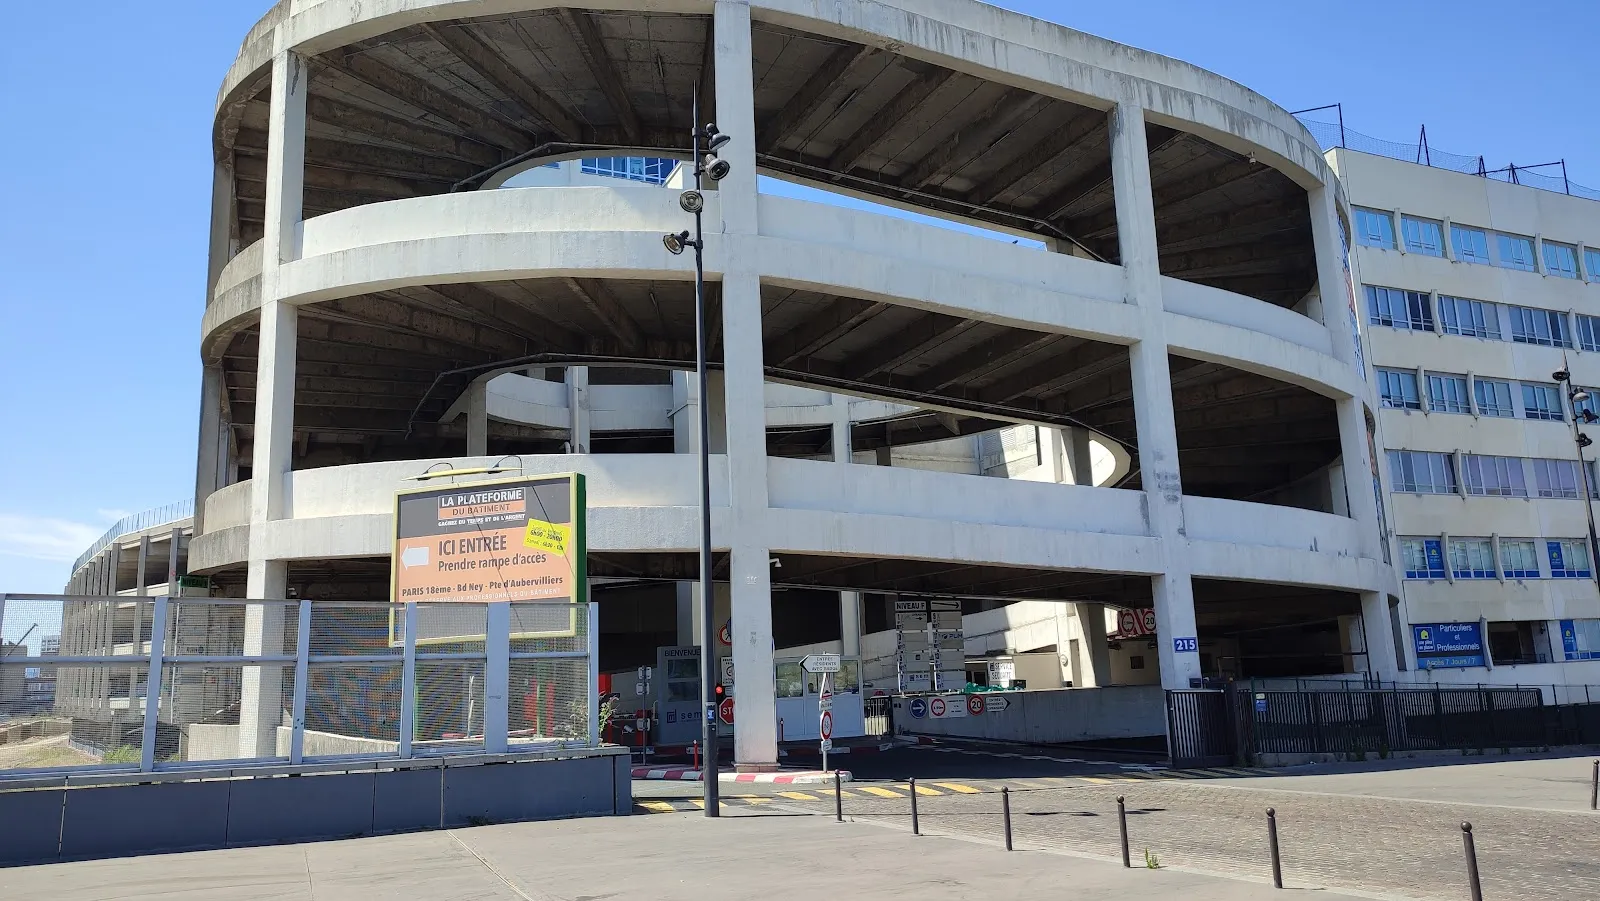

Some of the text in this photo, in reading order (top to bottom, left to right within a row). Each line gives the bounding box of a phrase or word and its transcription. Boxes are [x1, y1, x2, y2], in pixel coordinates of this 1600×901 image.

[441, 489, 522, 507] LA PLATEFORME
[452, 503, 511, 516] DU BATIMENT
[438, 532, 507, 556] ICI ENTRÉE
[438, 551, 547, 572] Prendre rampe d'accès
[402, 587, 424, 597] PARIS
[425, 585, 452, 595] 18ème
[457, 583, 467, 592] Bd
[469, 583, 484, 593] Ney
[489, 581, 502, 589] Pte
[503, 575, 564, 588] d'Aubervilliers
[896, 602, 920, 610] NIVEAU
[1145, 617, 1155, 625] 20
[1439, 624, 1473, 633] Particuliers
[1454, 633, 1461, 641] et
[1176, 640, 1196, 651] 215
[1436, 642, 1480, 652] Professionnels
[1426, 658, 1445, 666] Accès
[971, 700, 982, 709] 20
